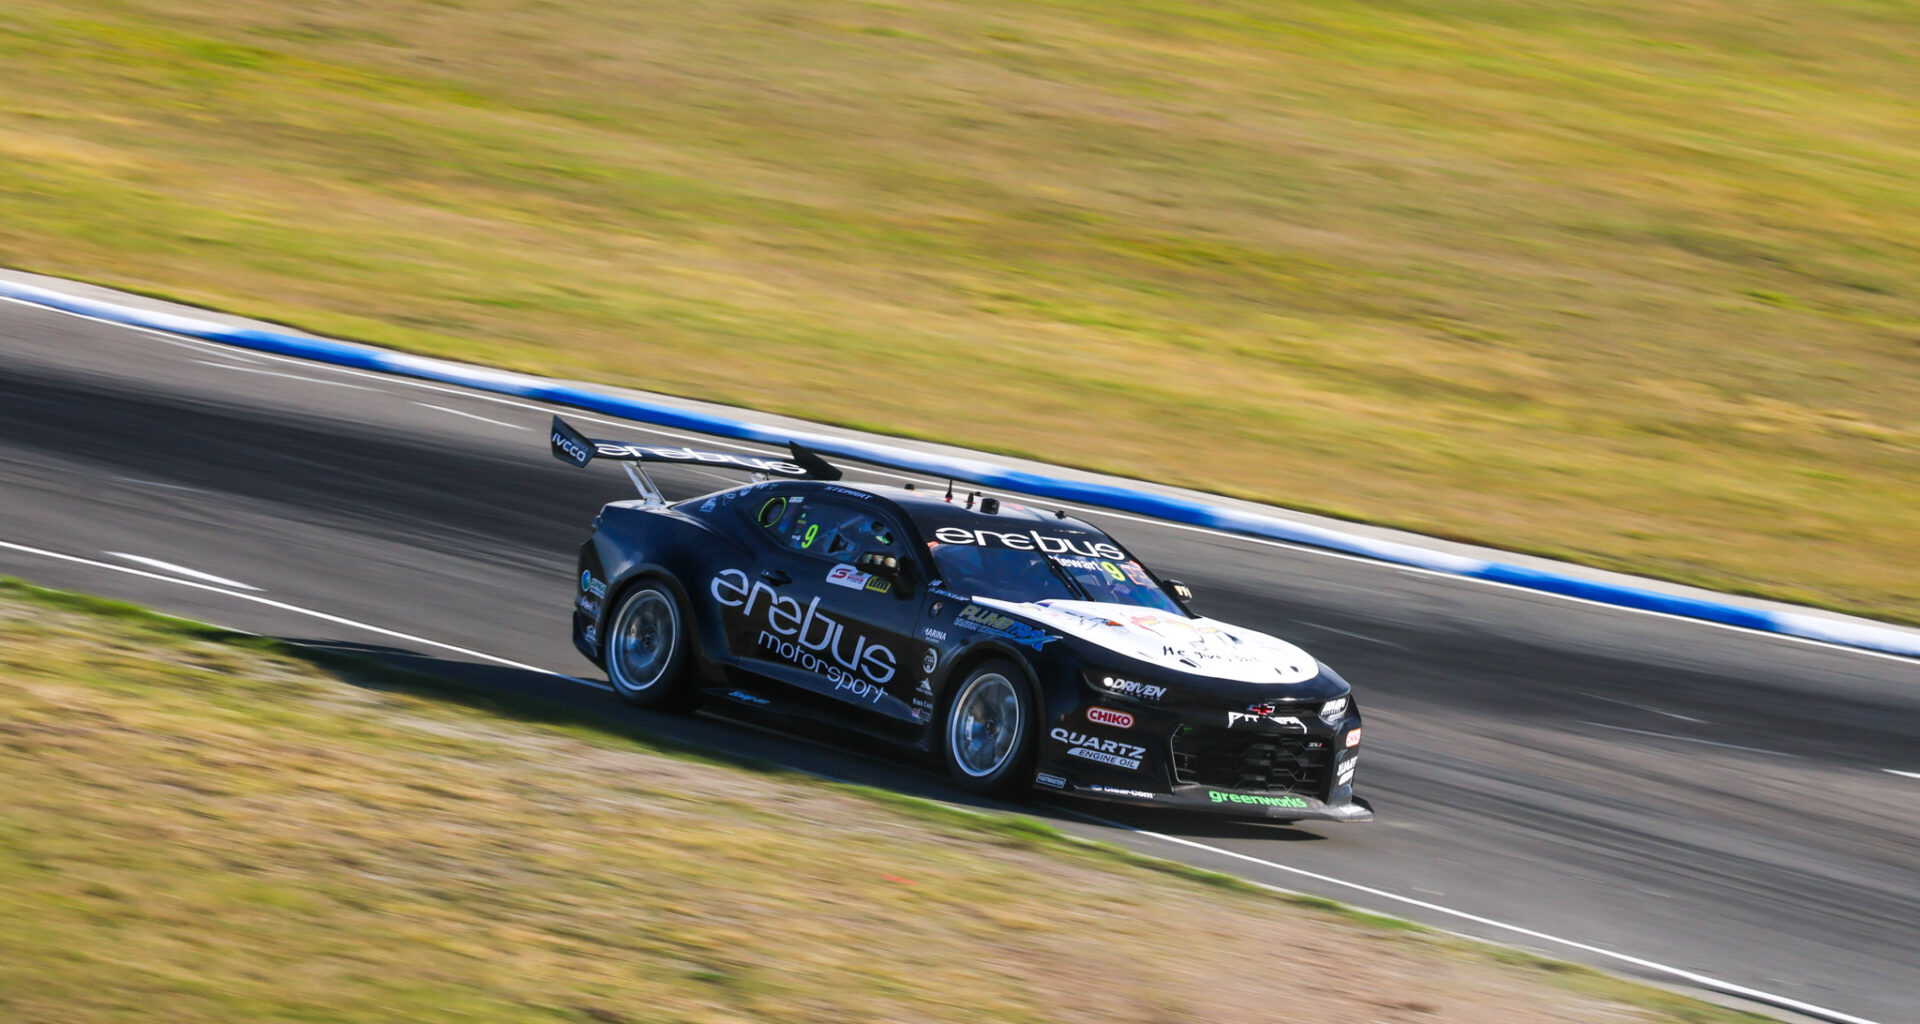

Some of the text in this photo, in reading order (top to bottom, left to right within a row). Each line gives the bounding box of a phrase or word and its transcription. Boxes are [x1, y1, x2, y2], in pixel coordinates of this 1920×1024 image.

[552, 433, 586, 462] IVCCO
[594, 443, 807, 475] erebus
[801, 524, 819, 548] 9
[935, 527, 1126, 561] erebus
[1101, 561, 1126, 581] 9
[710, 568, 897, 683] erebus
[758, 630, 889, 704] motorsport
[1112, 678, 1167, 698] DRIVEN
[1089, 709, 1132, 726] CHIKO
[1050, 727, 1147, 760] QUARTZ
[1078, 749, 1136, 769] ENGINE OIL
[1208, 789, 1307, 809] greenworks
